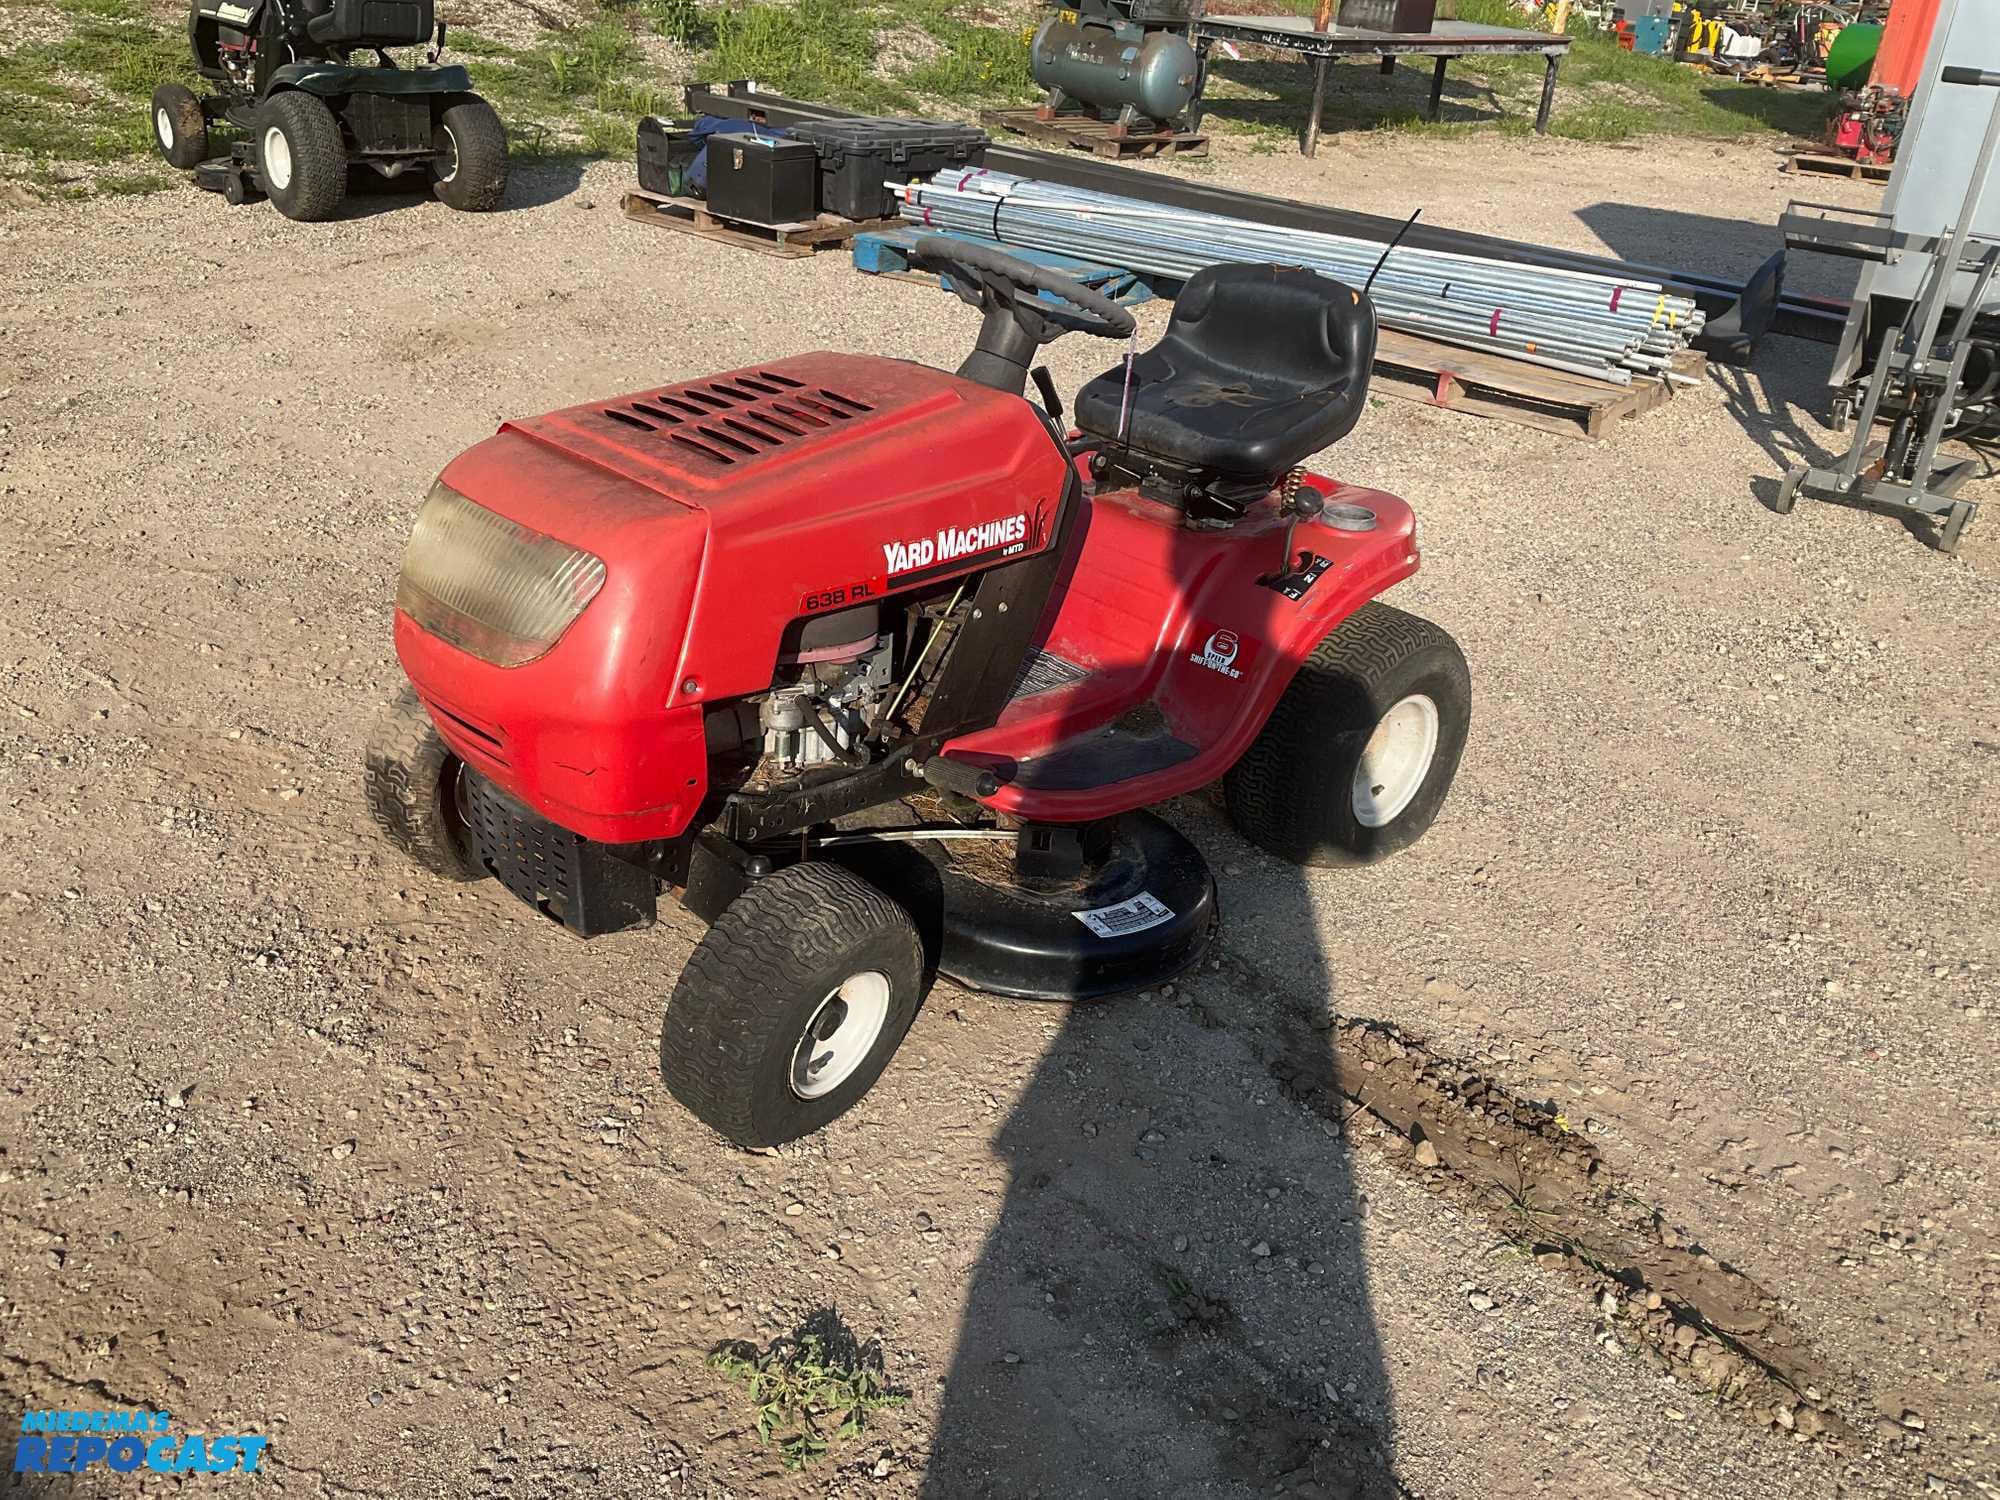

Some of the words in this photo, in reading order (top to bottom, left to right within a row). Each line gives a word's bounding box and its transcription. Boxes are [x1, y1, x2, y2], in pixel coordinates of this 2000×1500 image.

[883, 539, 934, 574] YARD
[937, 514, 1026, 561] MACHINES
[1008, 543, 1024, 555] MTD
[1303, 574, 1314, 583] N
[806, 589, 845, 610] 638
[851, 584, 875, 601] RL
[1213, 628, 1239, 656] 6
[1207, 653, 1226, 664] SPEED
